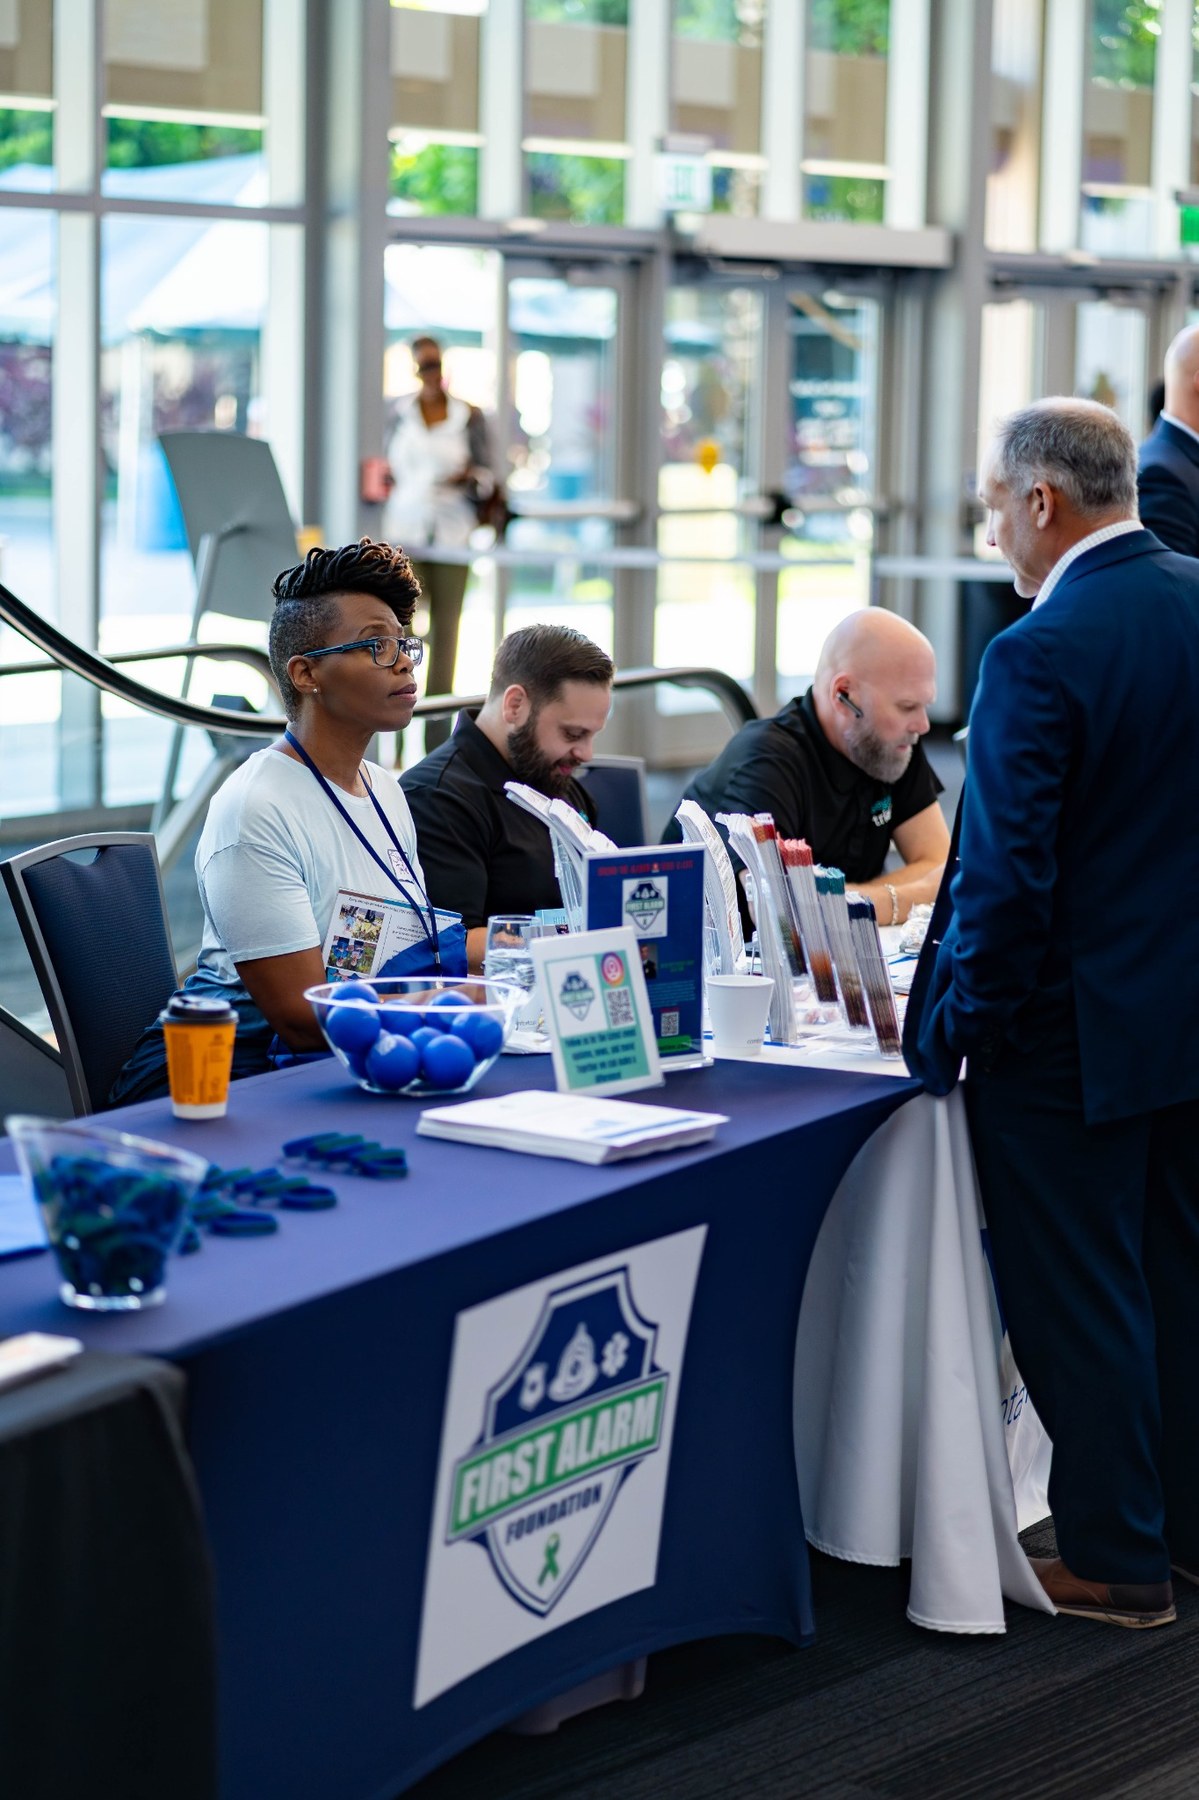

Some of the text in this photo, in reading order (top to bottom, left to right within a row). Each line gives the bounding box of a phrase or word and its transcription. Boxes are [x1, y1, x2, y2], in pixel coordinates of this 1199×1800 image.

[459, 1389, 660, 1522] FIRST ALARM
[507, 1484, 602, 1544] FOUNDATION
